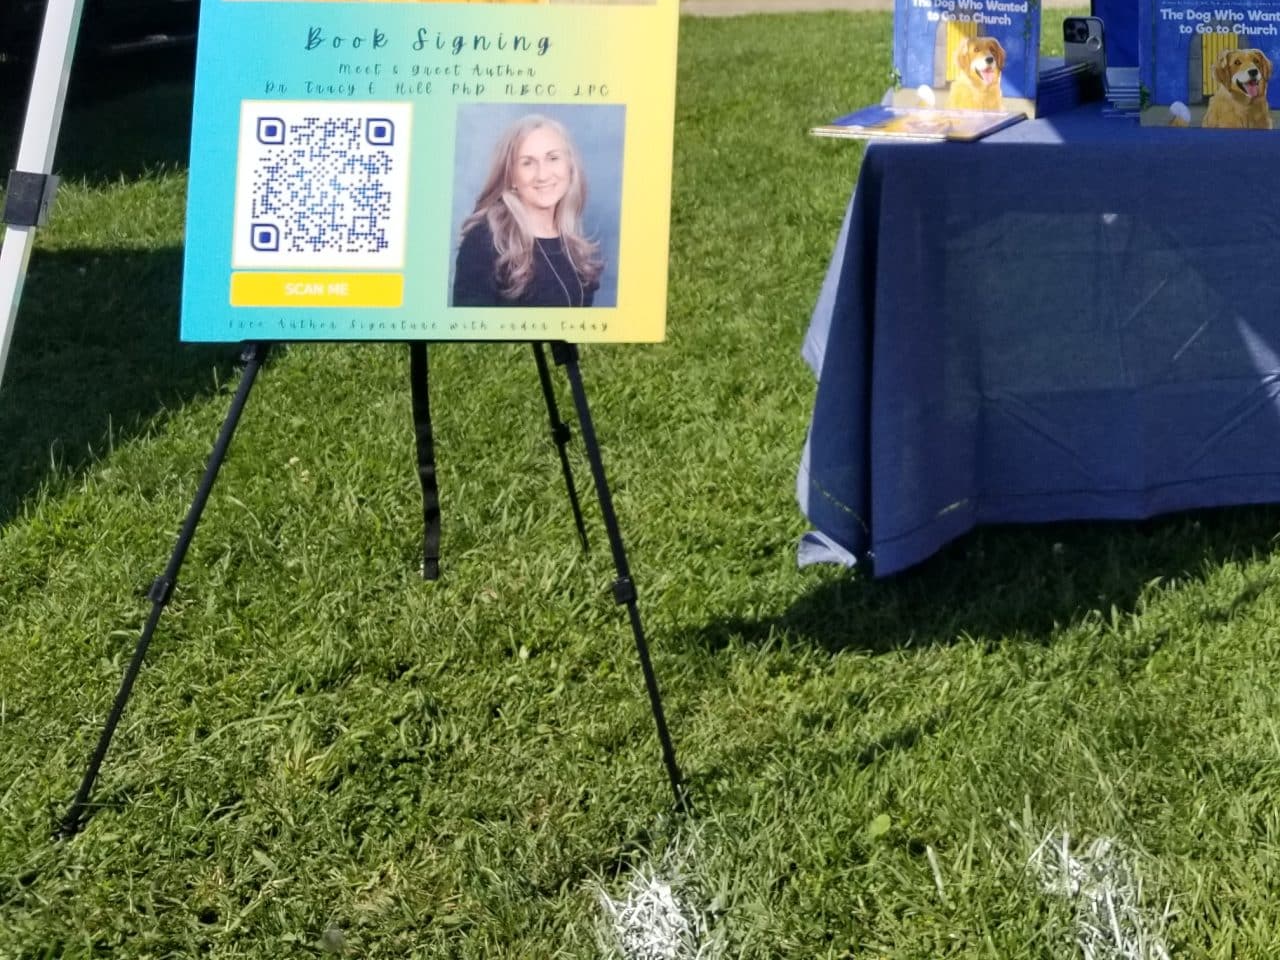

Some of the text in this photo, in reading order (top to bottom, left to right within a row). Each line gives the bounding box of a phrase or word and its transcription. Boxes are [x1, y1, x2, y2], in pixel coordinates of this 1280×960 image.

[986, 0, 1028, 14] Wanted
[927, 10, 1012, 26] to Go to Church
[1160, 8, 1182, 20] The
[1186, 9, 1211, 23] Dog
[1214, 9, 1244, 21] Who
[1179, 23, 1278, 36] to Go to Church
[304, 25, 553, 57] Book Signing
[472, 64, 537, 77] Author
[265, 80, 289, 94] Dr
[304, 80, 355, 97] Tracy
[395, 81, 433, 95] Hill
[452, 82, 486, 96] PhD
[284, 282, 350, 297] SCAN ME
[277, 317, 338, 330] Author
[349, 318, 437, 332] Signature
[449, 320, 488, 332] with
[559, 320, 609, 333] today
